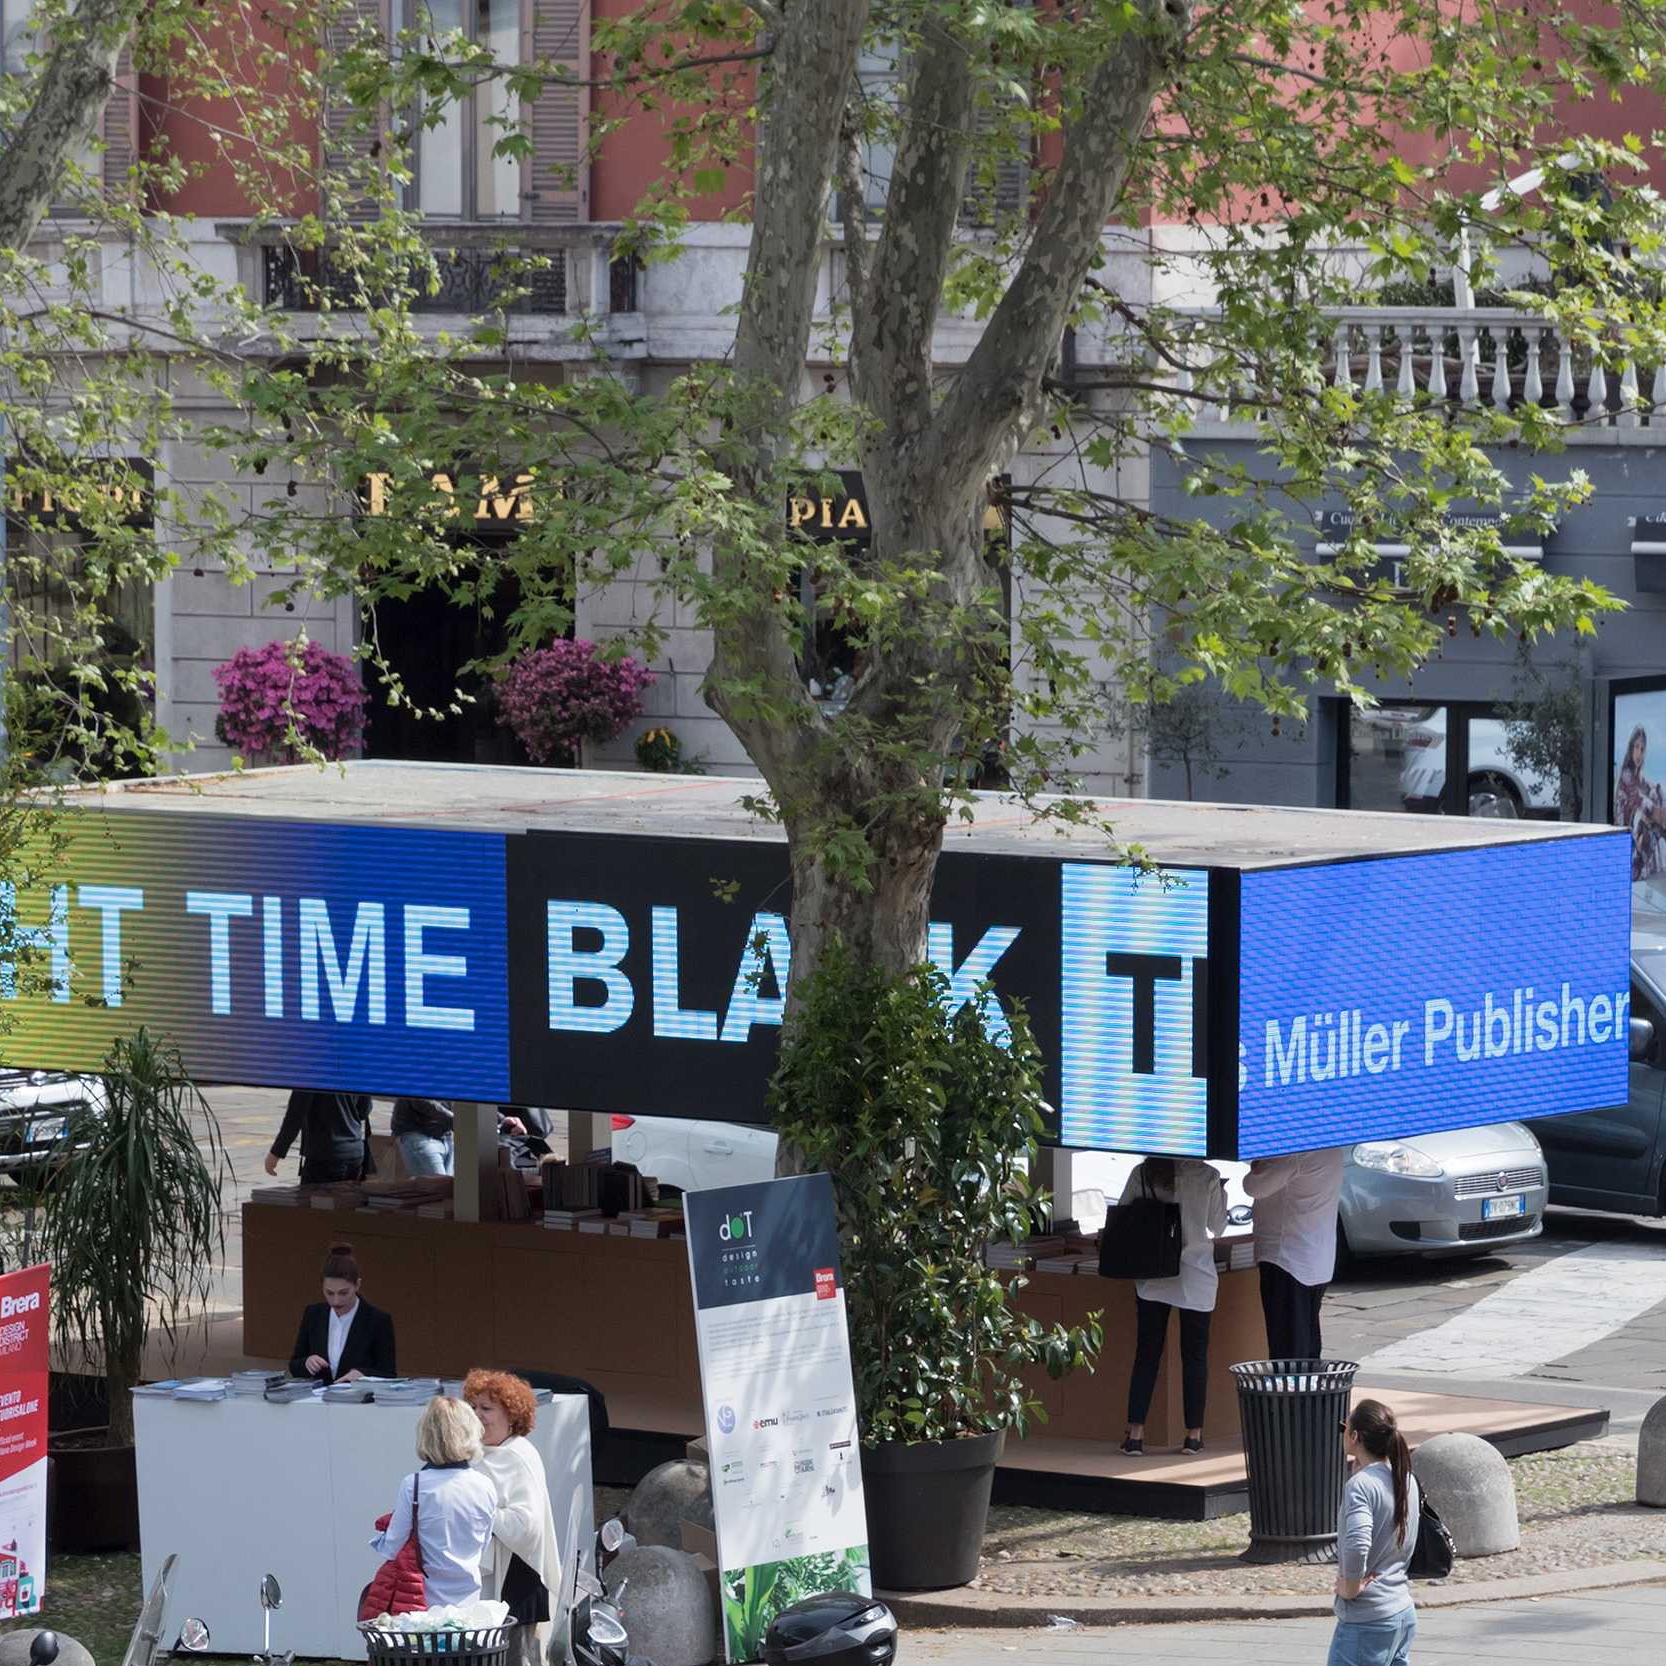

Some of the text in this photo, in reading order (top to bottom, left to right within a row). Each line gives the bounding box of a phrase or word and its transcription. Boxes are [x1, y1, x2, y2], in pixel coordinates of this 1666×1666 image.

[186, 891, 475, 1031] TIME
[547, 899, 1022, 1062] BLAK
[1265, 1012, 1410, 1088] Müller
[1424, 981, 1630, 1066] Publisher
[722, 1250, 758, 1263] design
[724, 1274, 761, 1287] taste
[0, 1291, 40, 1319] Brera
[759, 1416, 779, 1428] emu
